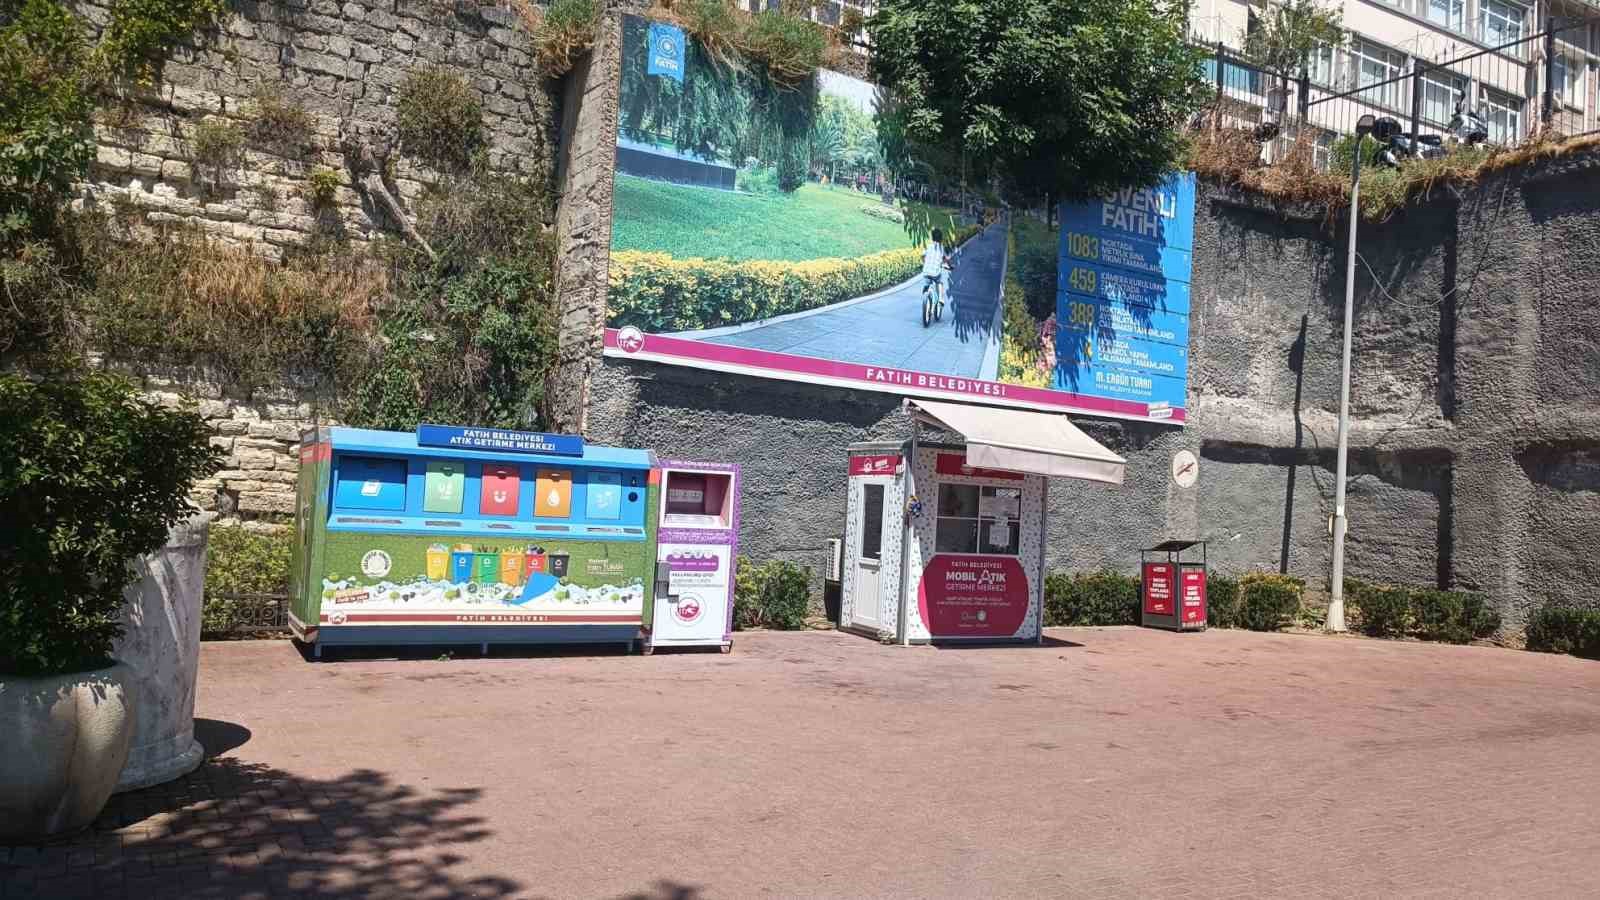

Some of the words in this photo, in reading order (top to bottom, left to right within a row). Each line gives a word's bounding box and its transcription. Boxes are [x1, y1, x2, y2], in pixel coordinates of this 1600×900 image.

[1102, 203, 1158, 238] FATİH
[1067, 231, 1098, 259] 1083
[1069, 267, 1096, 293] 459
[1069, 301, 1095, 324] 388
[918, 374, 1006, 396] BELEDİYESİ
[450, 436, 472, 445] ATIK
